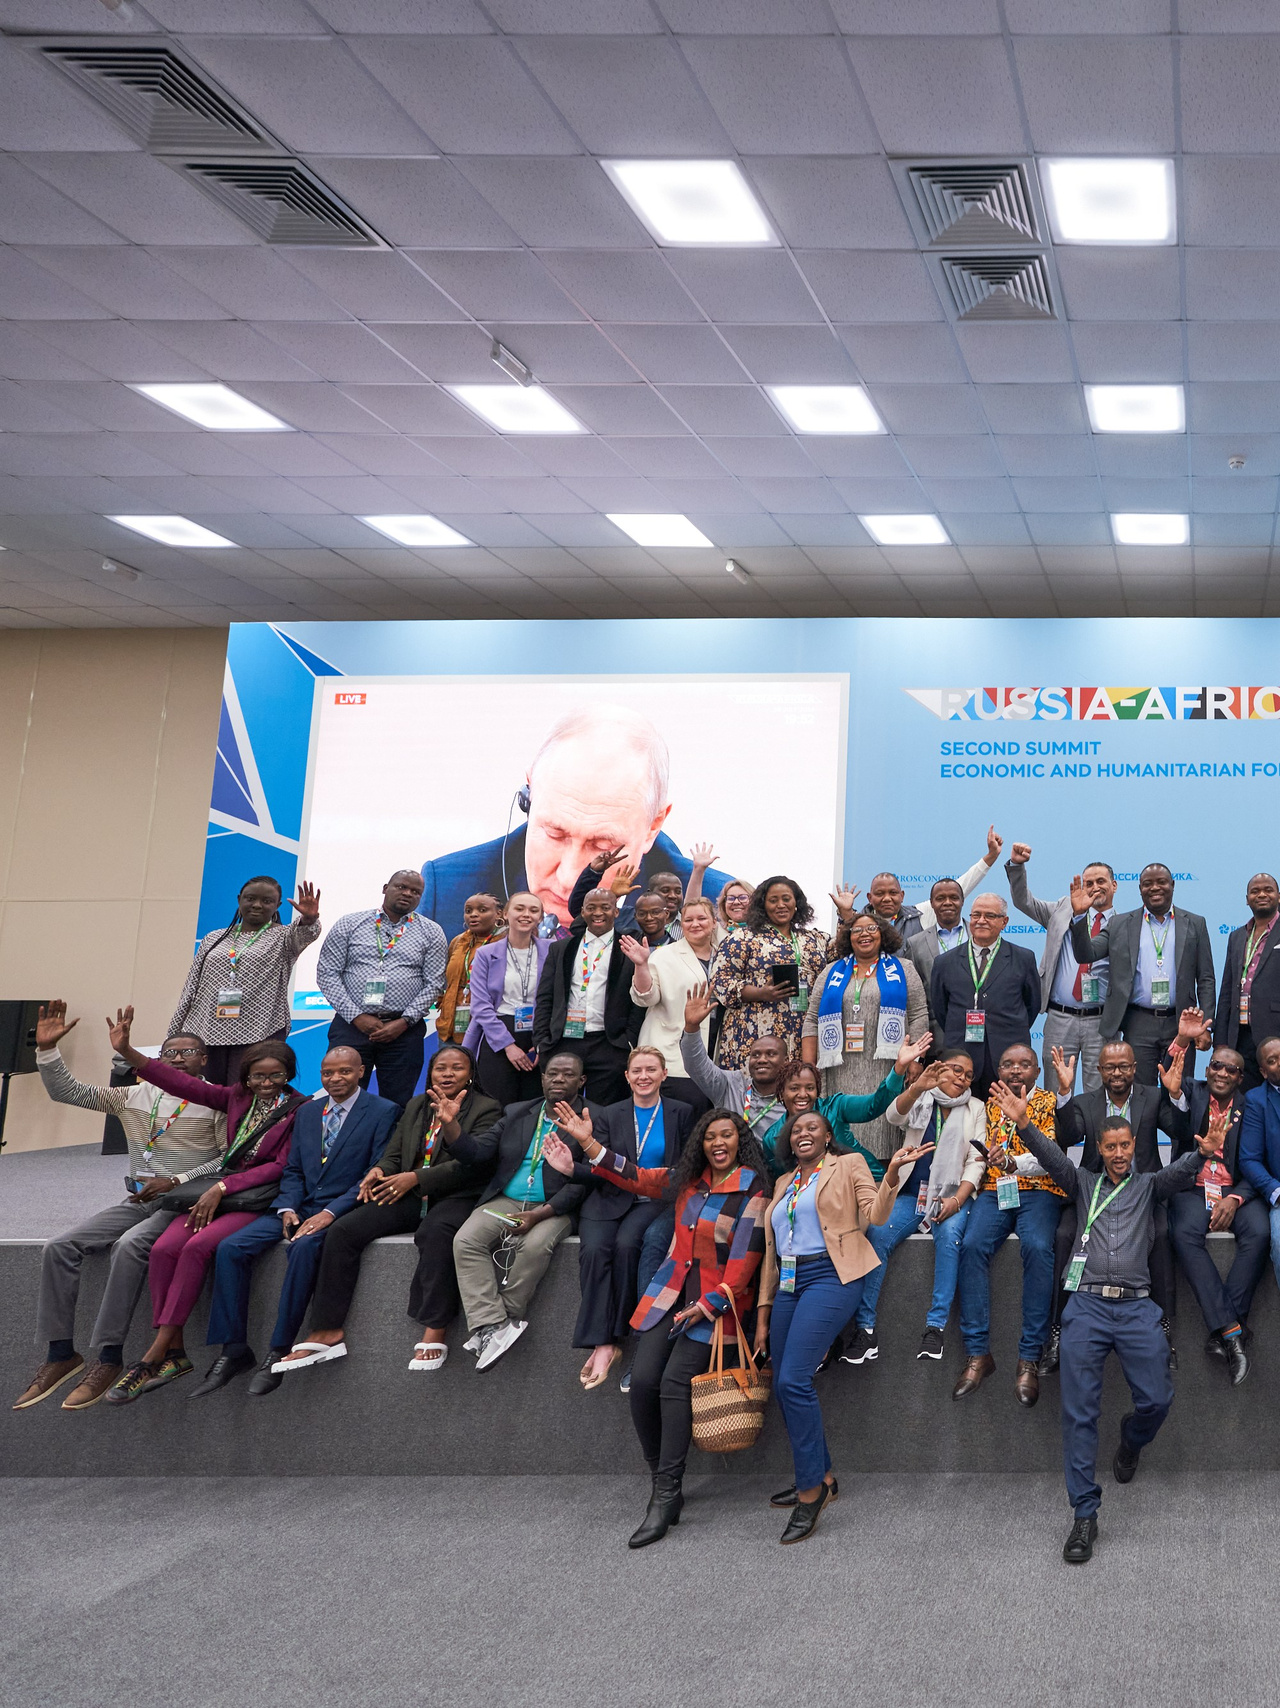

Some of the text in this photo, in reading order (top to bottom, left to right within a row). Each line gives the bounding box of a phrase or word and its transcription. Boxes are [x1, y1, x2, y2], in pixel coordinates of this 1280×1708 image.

[340, 694, 362, 704] LIVE
[940, 741, 1101, 756] SECOND SUMMIT
[940, 764, 1045, 778] ECONOMIC
[1050, 764, 1091, 777] AND
[1097, 763, 1245, 777] HUMANITARIAN
